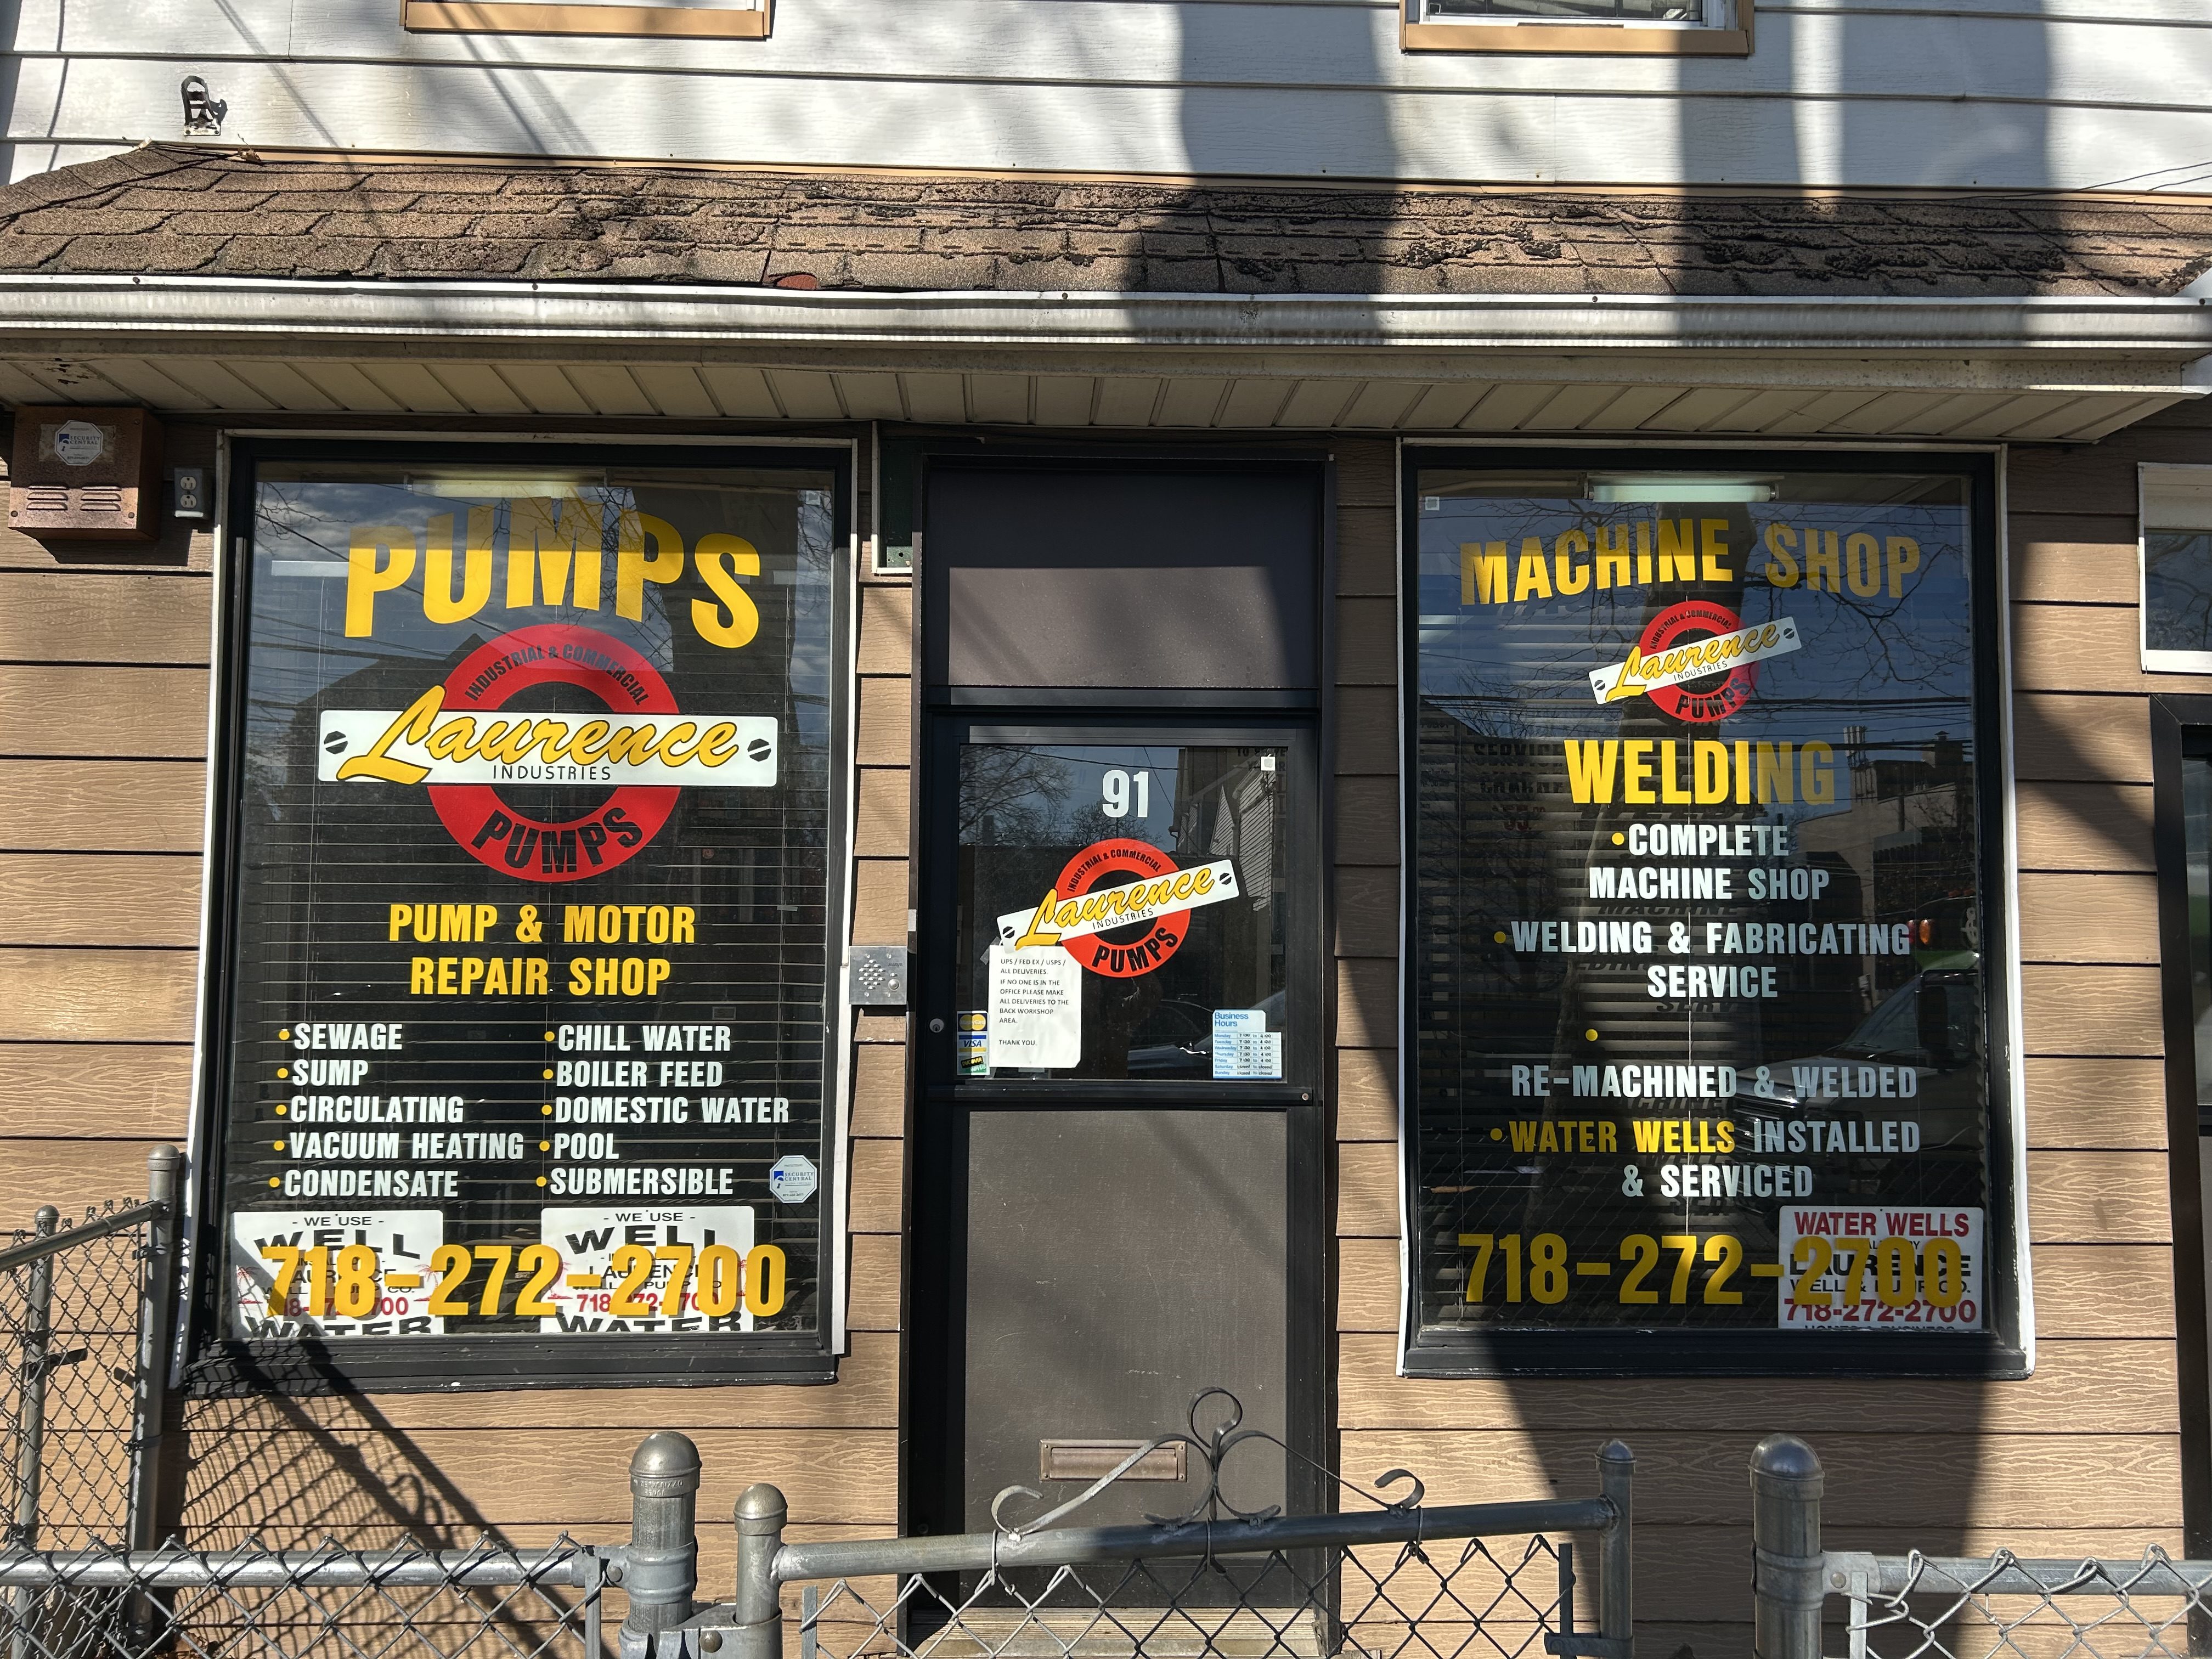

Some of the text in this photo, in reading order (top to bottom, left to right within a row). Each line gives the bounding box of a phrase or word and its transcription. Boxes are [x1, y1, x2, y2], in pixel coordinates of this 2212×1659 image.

[345, 498, 760, 648] PUMPS
[1460, 518, 1921, 606] MACHINE SHOP
[1650, 615, 1679, 650] INDUSTRIAL
[1686, 610, 1732, 629] COMMERCIAL
[465, 644, 650, 706] INDUSTRIAL & COMMERCIAL
[1606, 620, 1780, 703] Laurence
[1673, 661, 1728, 681] INDUSTRIES
[1675, 678, 1750, 719] PUMPS
[336, 685, 738, 785] Laurence
[493, 765, 611, 781] INDUSTRIES
[1564, 740, 1836, 805] WELDING
[1102, 769, 1149, 818] 91
[471, 808, 643, 874] PUMPS
[1628, 825, 1790, 857] COMPLETE
[1067, 854, 1103, 893] INDUSTRIAL
[1110, 849, 1161, 872] COMMERCIAL
[1589, 867, 1829, 900] MACHINE SHOP
[388, 904, 695, 944] PUMP & MOTOR
[1015, 868, 1214, 951] Laurence
[1092, 908, 1154, 930] INDUSTRIES
[1092, 927, 1178, 973] PUMPS
[1510, 922, 1911, 955] WELDING & FABRICATING
[410, 957, 672, 996] REPAIR SHOP
[1646, 966, 1778, 998] SERVICE
[293, 1023, 403, 1051] SEWAGE
[557, 1024, 730, 1052] CHILL WATER
[292, 1059, 369, 1087] SUMP
[556, 1060, 723, 1087] BOILER FEED
[1511, 1065, 1917, 1098] RE-MACHINED & WELDED
[290, 1096, 464, 1123] CIRCULATING
[555, 1097, 789, 1124] DOMESTIC WATER
[290, 1133, 523, 1160] VACUUM HEATING
[554, 1133, 619, 1160] POOL
[1509, 1121, 1920, 1153] WATER WELLS INSTALLED
[284, 1170, 459, 1198] CONDENSATE
[550, 1167, 733, 1195] SUBMERSIBLE
[1622, 1165, 1813, 1198] & SERVICED
[304, 1217, 331, 1226] WE
[338, 1216, 372, 1226] USE
[616, 1213, 642, 1222] WE
[650, 1212, 683, 1221] USE
[1794, 1212, 1970, 1237] WATER WELLS
[253, 1229, 420, 1260] WELL
[262, 1244, 786, 1317] 718-272-2700
[1458, 1233, 1962, 1308] 718-272-2700
[555, 1312, 742, 1332] WATER
[1784, 1299, 1977, 1323] 718-272-2700
